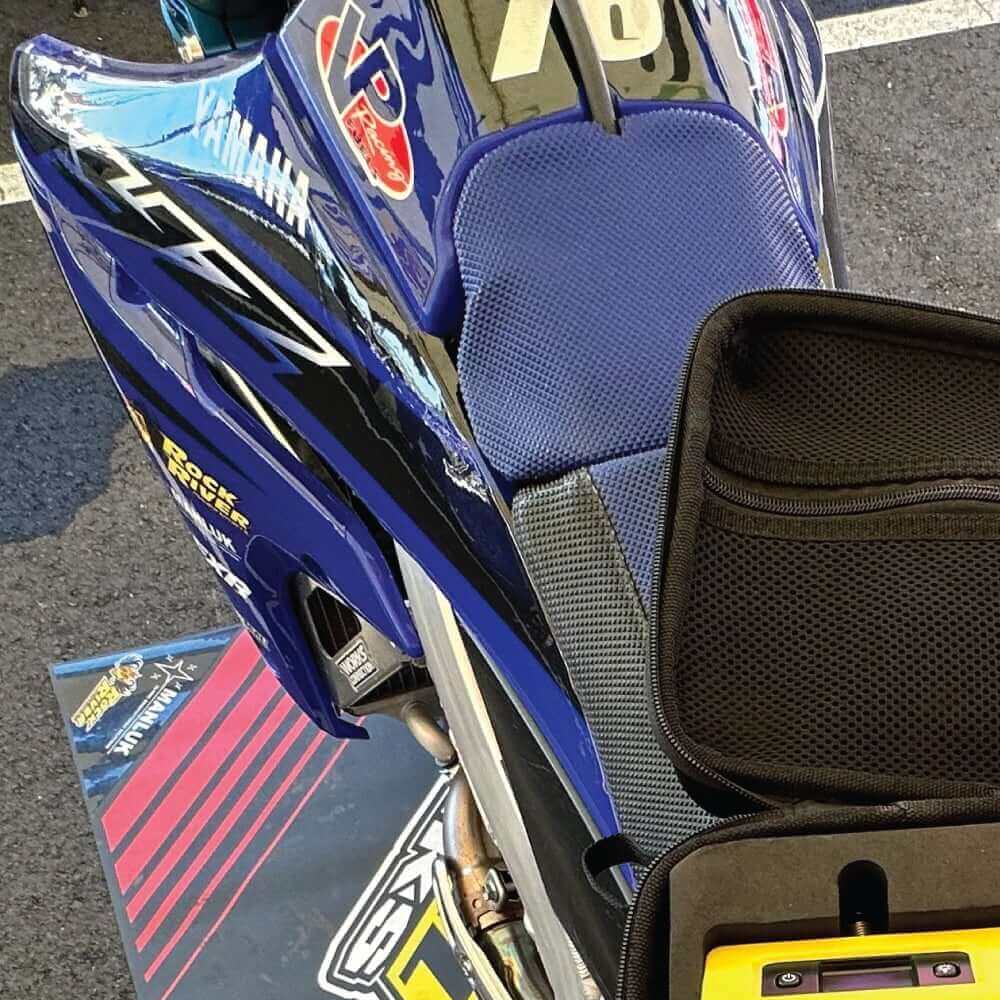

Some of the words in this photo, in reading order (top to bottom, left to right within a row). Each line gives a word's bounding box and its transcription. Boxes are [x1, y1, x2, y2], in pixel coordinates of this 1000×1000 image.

[195, 80, 311, 239] YAMAHA
[161, 433, 240, 506] ROCK
[167, 457, 251, 531] RIVER
[117, 682, 183, 757] MANLUK
